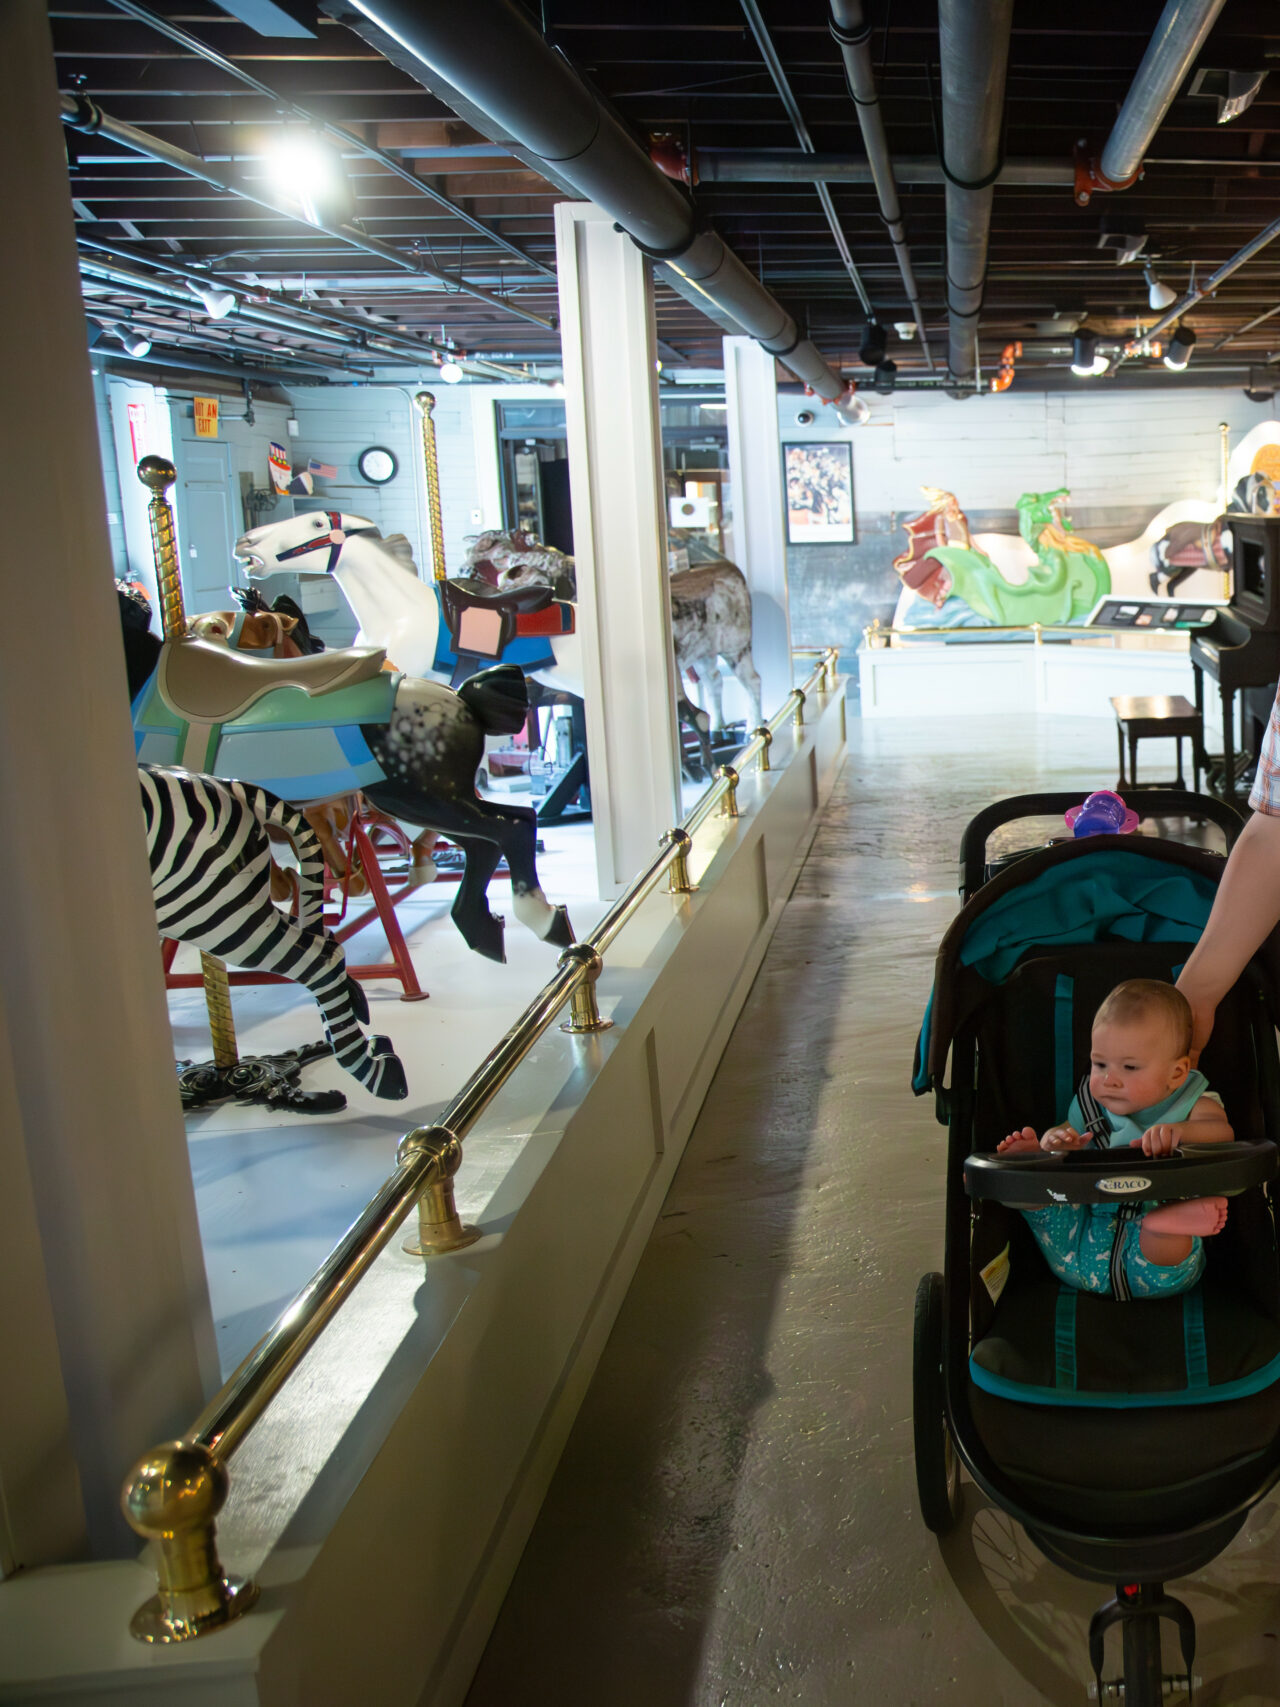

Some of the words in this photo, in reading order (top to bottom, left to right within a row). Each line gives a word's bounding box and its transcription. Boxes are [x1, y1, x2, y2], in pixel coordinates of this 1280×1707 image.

[207, 403, 217, 418] AN
[199, 419, 211, 433] EXIT
[1103, 1180, 1148, 1190] GRACO
